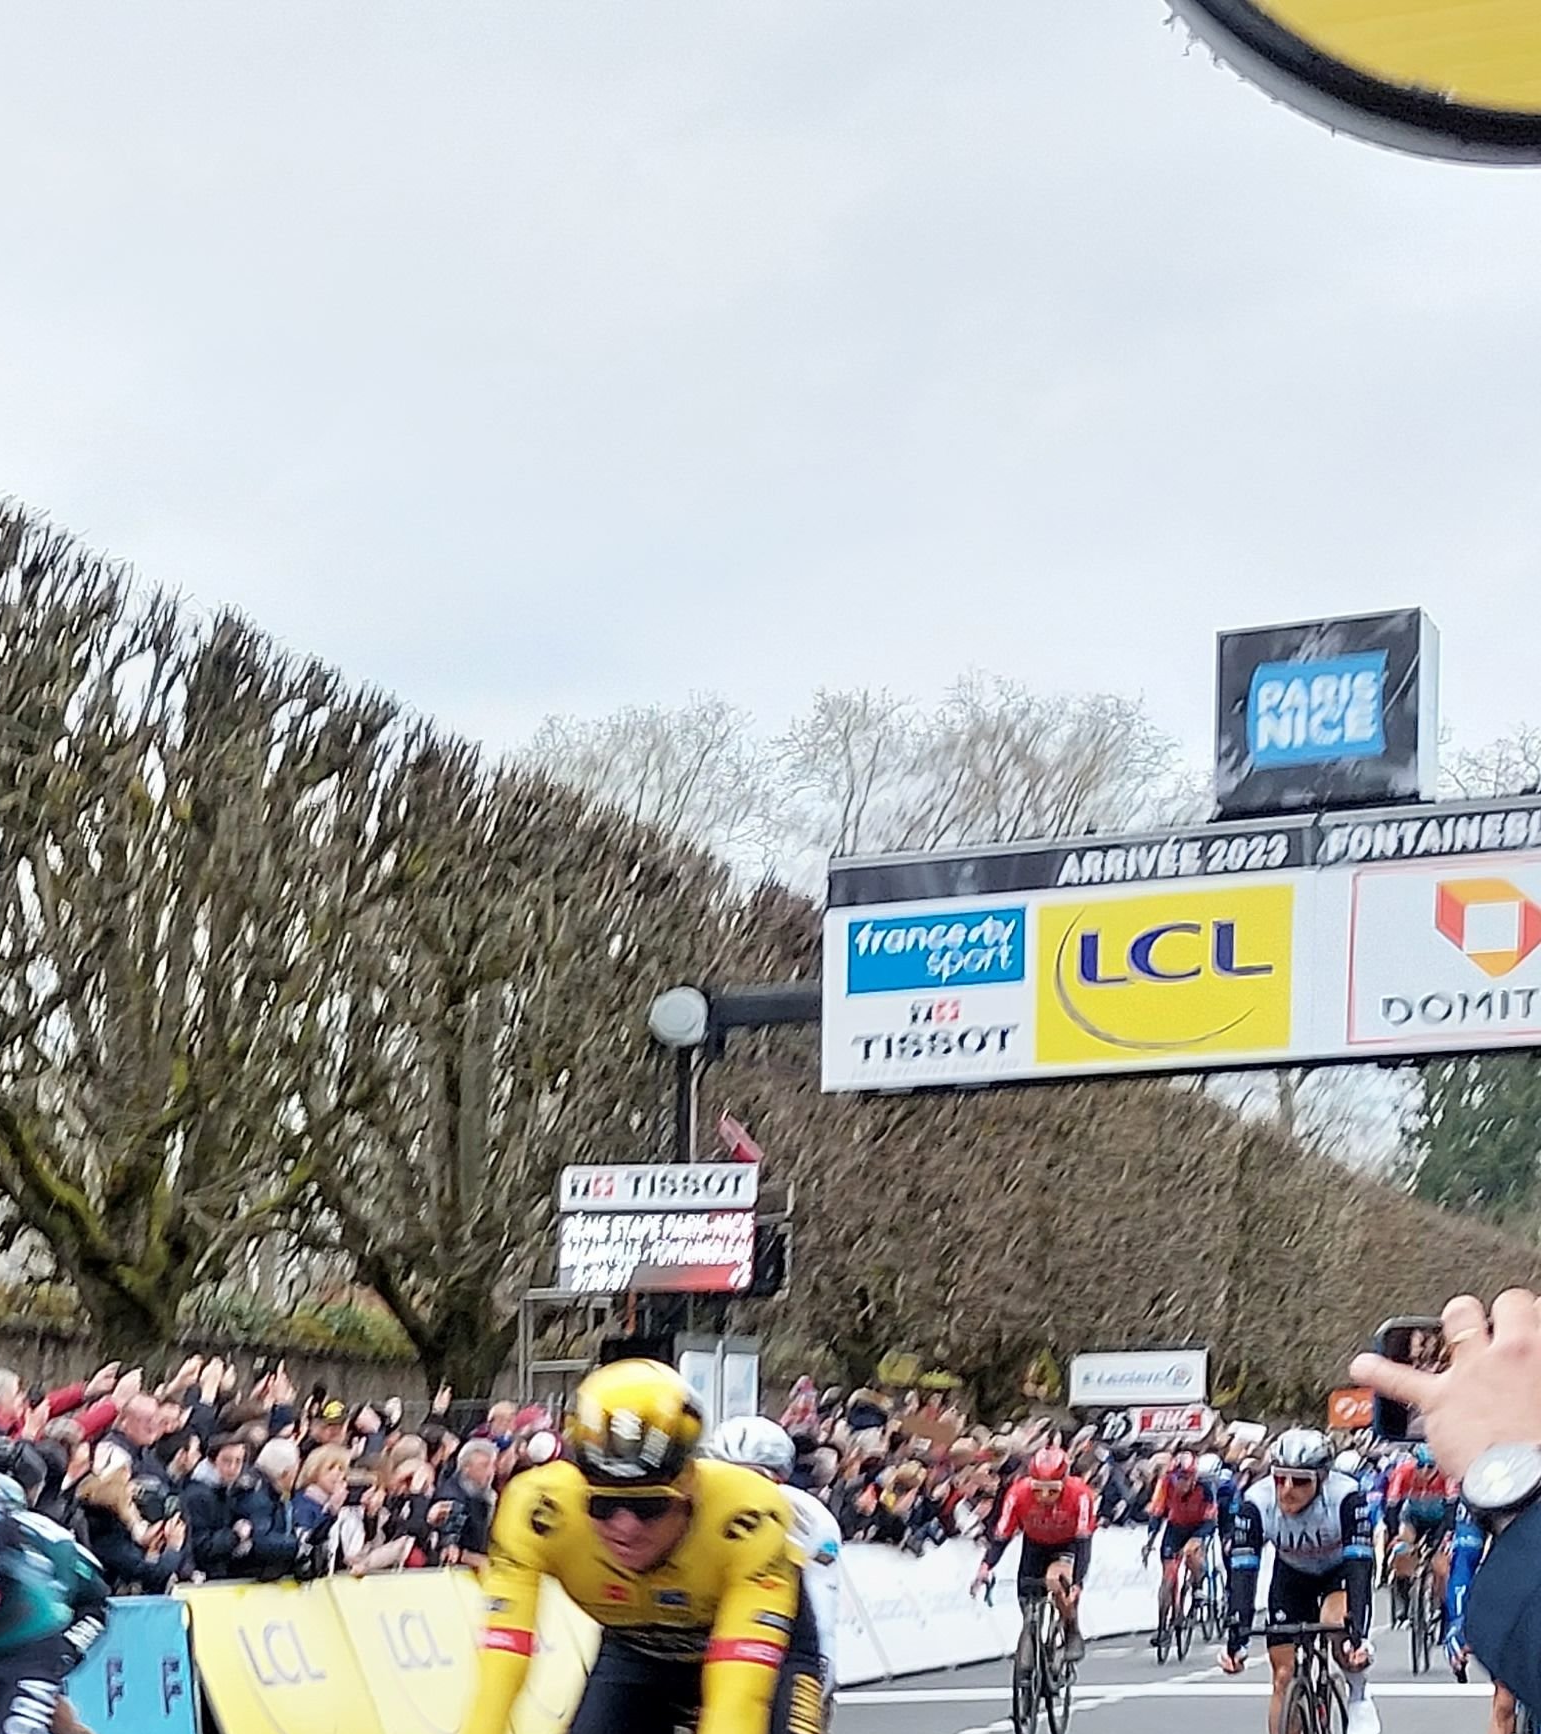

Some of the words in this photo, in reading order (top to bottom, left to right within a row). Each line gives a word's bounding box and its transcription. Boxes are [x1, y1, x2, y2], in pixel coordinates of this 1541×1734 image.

[1257, 671, 1378, 714] PARIS
[1257, 705, 1378, 751] NICE
[1205, 833, 1288, 873] 2023
[925, 943, 1013, 985] sport
[1078, 918, 1274, 986] LCL
[851, 1023, 1019, 1065] TISSOT
[625, 1170, 749, 1198] TISSOT
[238, 1624, 327, 1687] LCL
[381, 1610, 454, 1669] LCL
